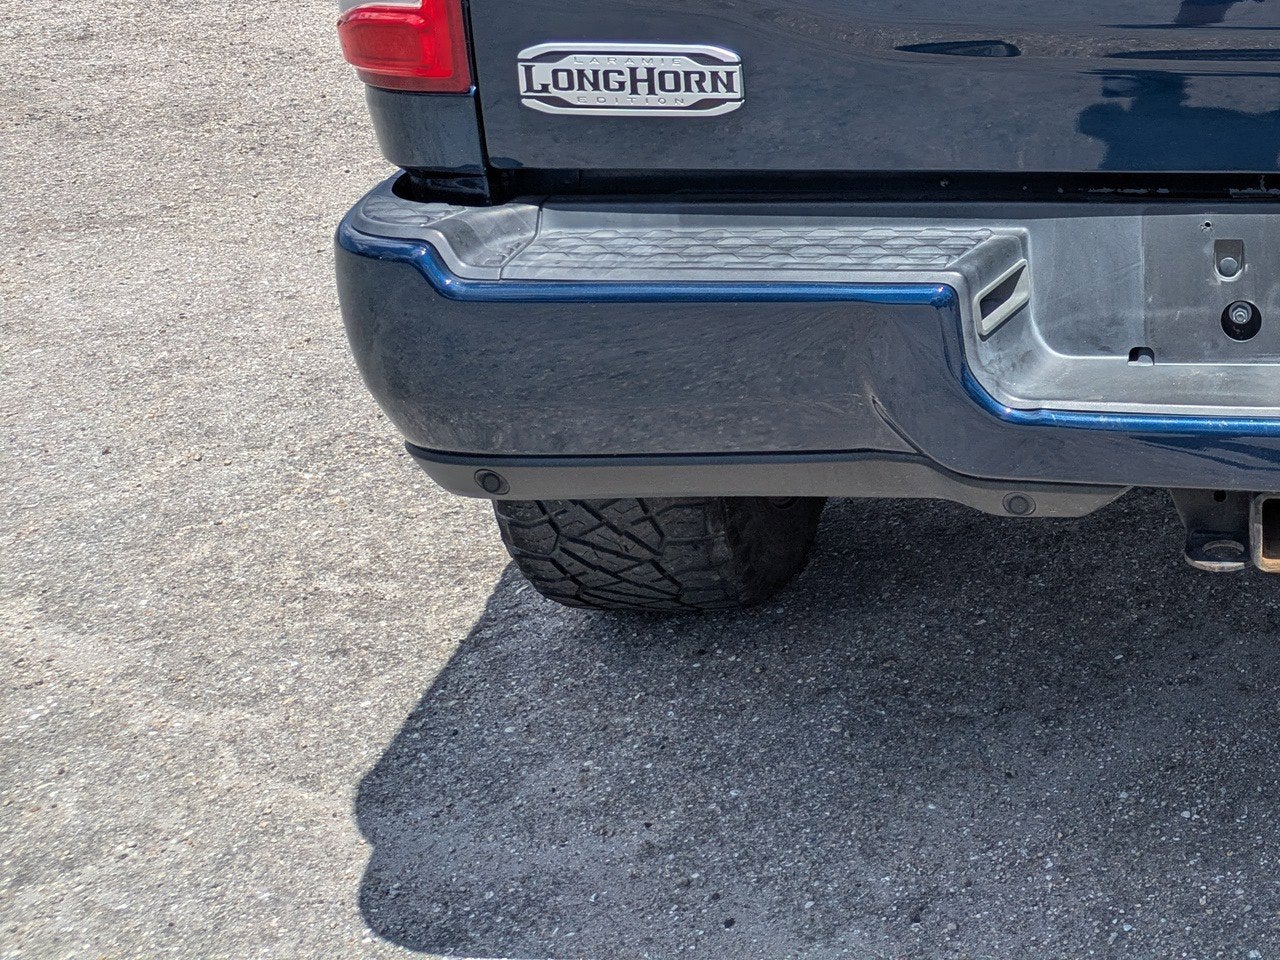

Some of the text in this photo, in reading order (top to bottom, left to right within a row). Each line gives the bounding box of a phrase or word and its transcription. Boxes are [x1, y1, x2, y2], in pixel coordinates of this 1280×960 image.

[573, 56, 682, 66] LARAMIE
[521, 64, 739, 96] LONGHORN
[577, 96, 685, 106] EDITION
